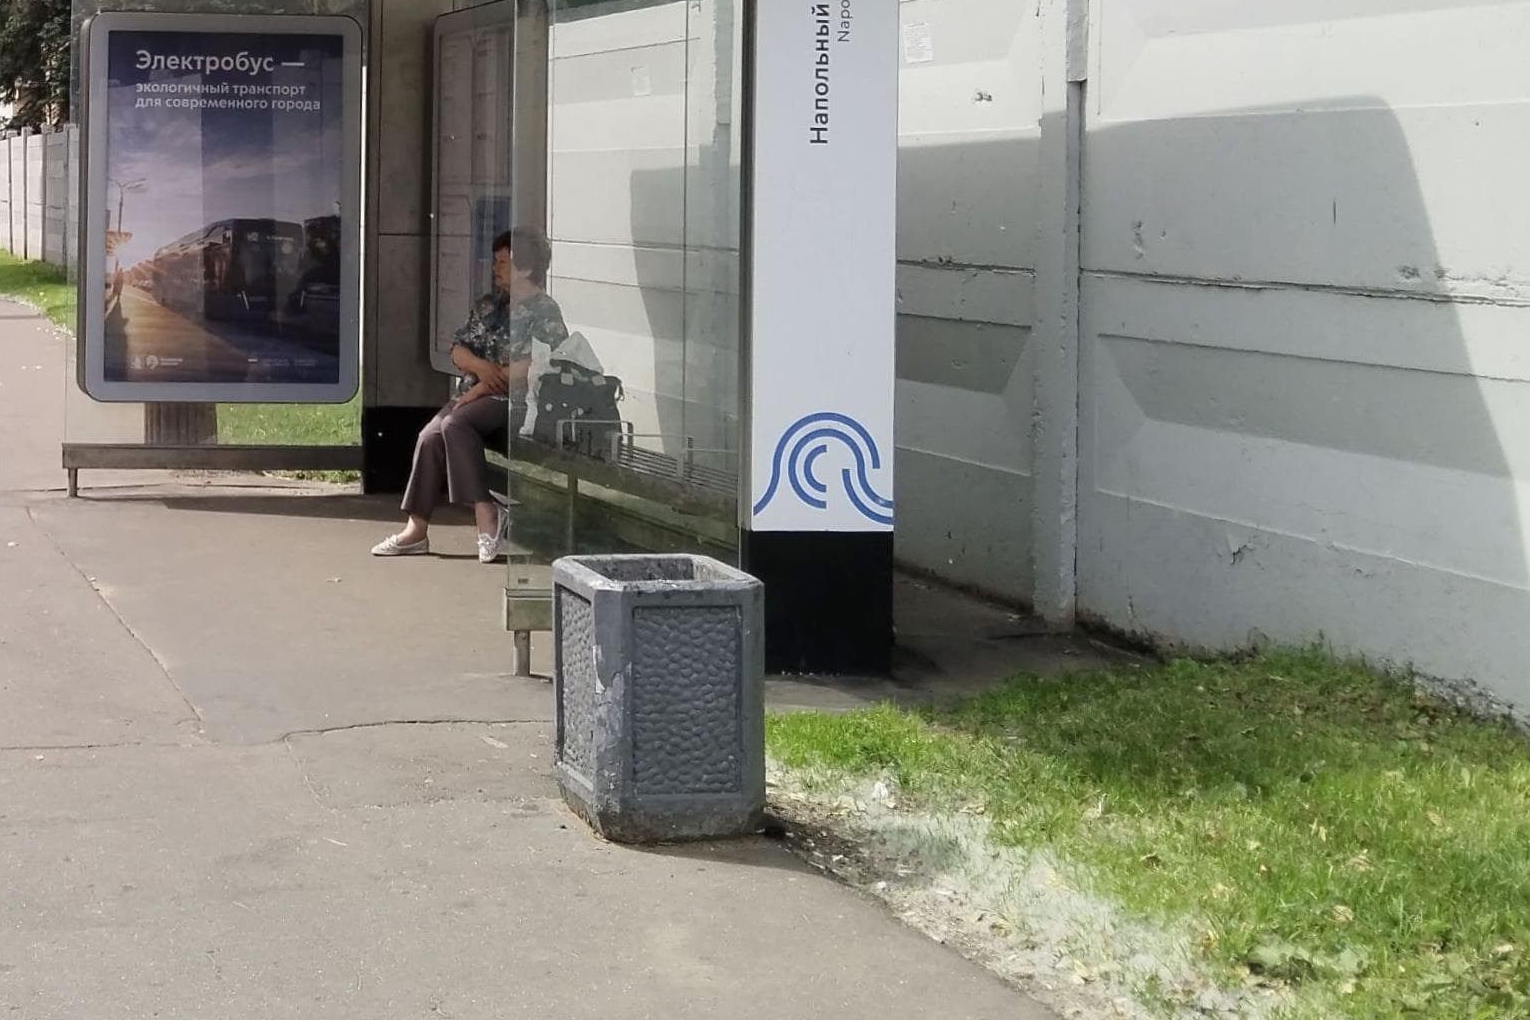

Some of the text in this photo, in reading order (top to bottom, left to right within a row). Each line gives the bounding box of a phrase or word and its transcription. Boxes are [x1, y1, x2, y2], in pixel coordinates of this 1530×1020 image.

[135, 50, 274, 75] Электробус
[810, 4, 829, 145] Напольный
[135, 82, 306, 97] экологичный транспорт
[135, 97, 320, 111] для современного города
